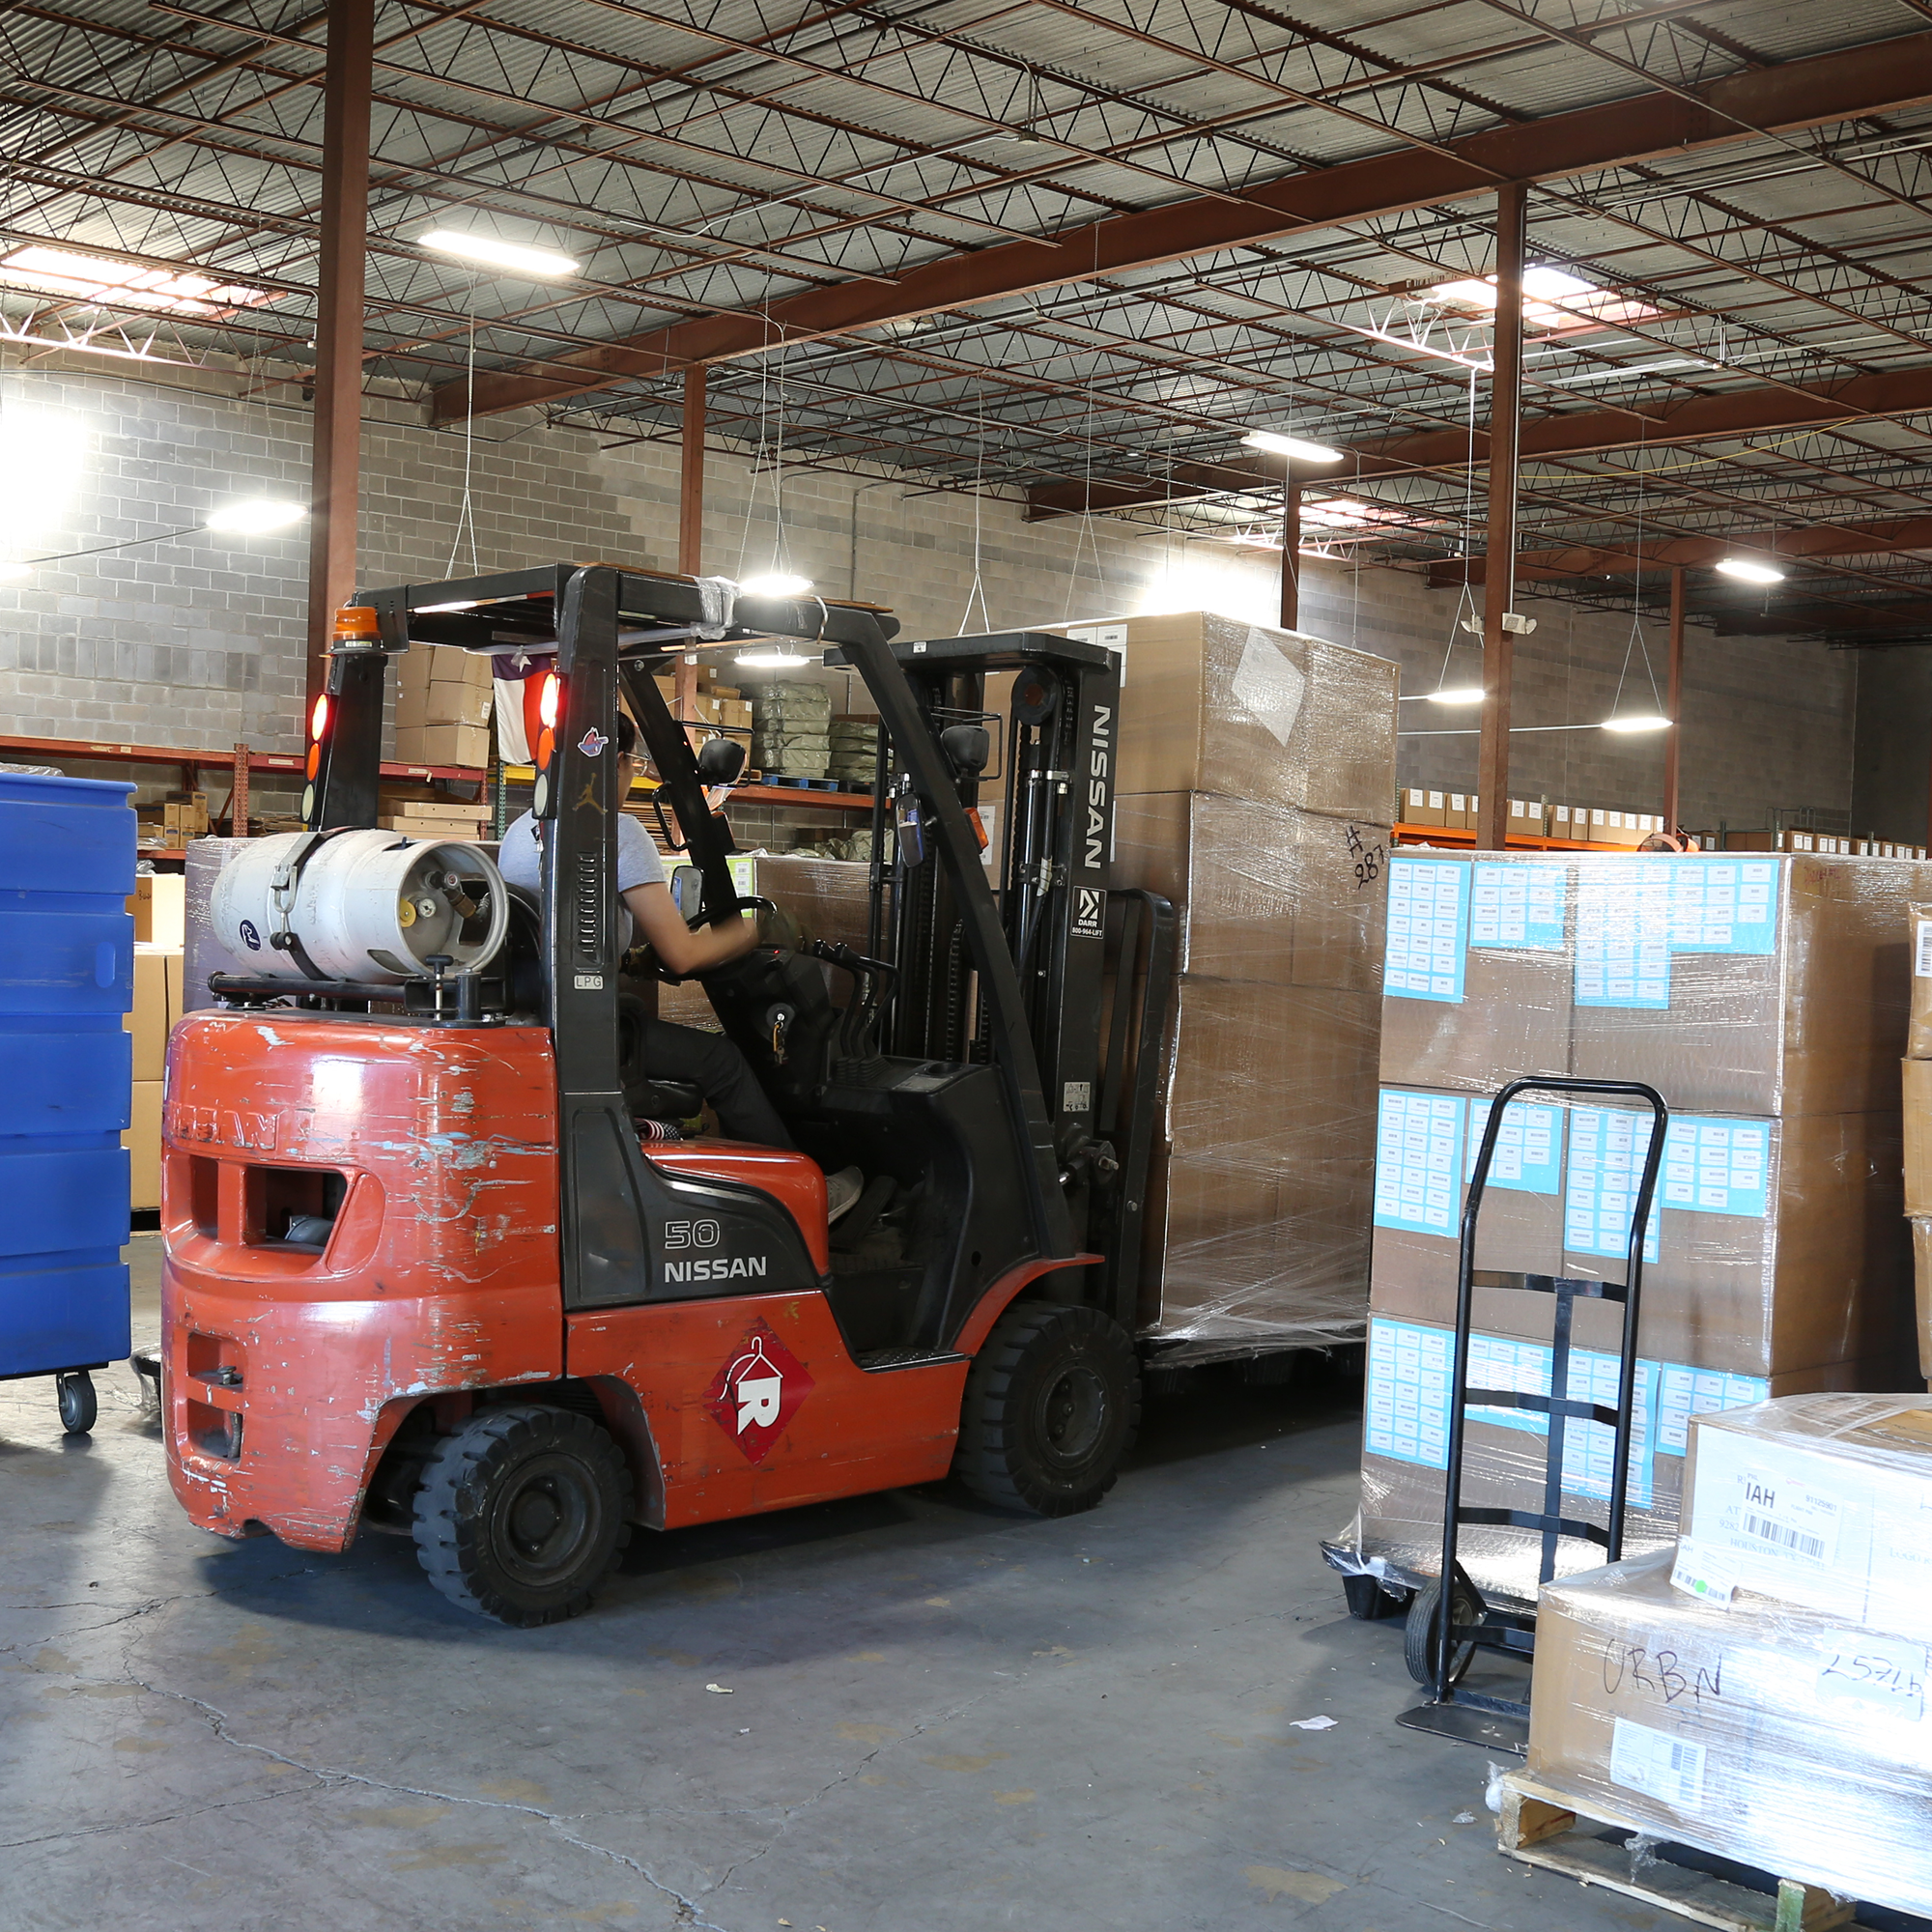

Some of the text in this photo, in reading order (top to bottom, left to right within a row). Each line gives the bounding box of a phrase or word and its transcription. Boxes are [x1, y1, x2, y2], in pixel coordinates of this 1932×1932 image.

[1085, 705, 1111, 868] NISSAN
[1072, 926, 1102, 937] 800-964-LIFT
[1078, 919, 1097, 927] DARR
[577, 977, 601, 987] LPG
[665, 1219, 720, 1250] 50
[665, 1257, 767, 1283] NISSAN
[1746, 1482, 1776, 1509] IAH
[1730, 1537, 1778, 1557] HOUSTON
[1604, 1638, 1721, 1704] URBN
